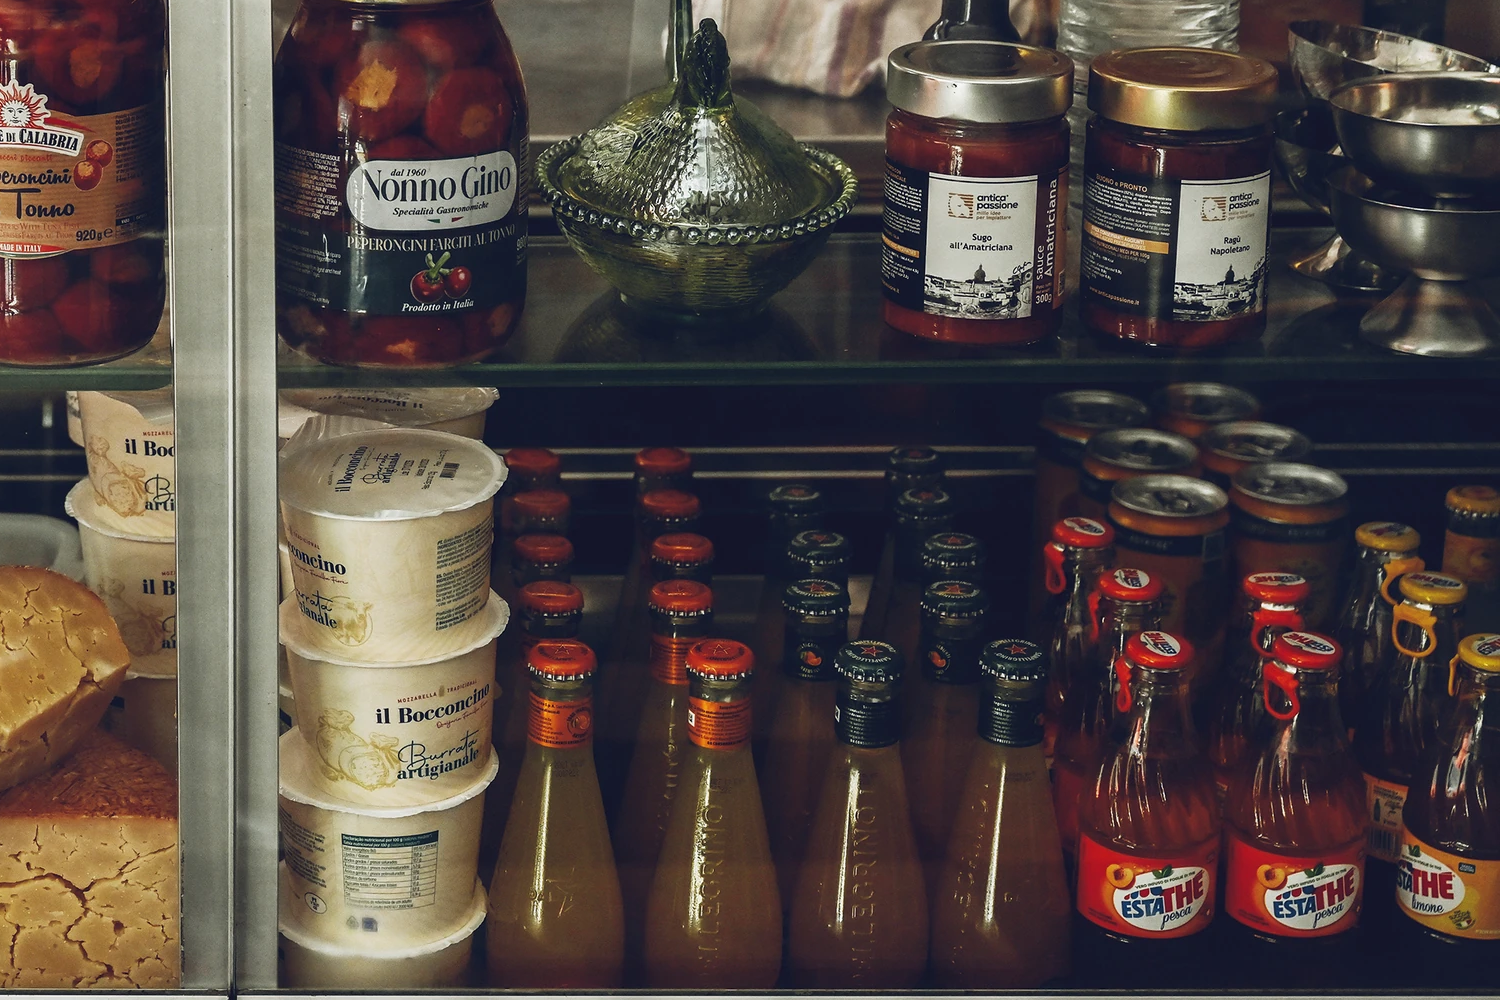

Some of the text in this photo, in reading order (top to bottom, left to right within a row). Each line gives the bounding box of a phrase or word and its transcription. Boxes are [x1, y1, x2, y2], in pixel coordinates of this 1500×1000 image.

[6, 132, 16, 143] DI
[19, 128, 79, 151] CALABRIA
[390, 168, 427, 178] dal 1960
[363, 168, 457, 202] Nonno
[460, 165, 511, 200] Gino
[1119, 181, 1148, 193] PRONTO
[0, 187, 75, 220] Tonno
[976, 194, 1006, 203] antica
[1228, 198, 1260, 212] passione
[1229, 192, 1253, 202] antica
[392, 200, 490, 218] Specialità Gastronomiche
[976, 200, 1018, 212] passione
[1044, 178, 1058, 278] Amatriciana
[347, 235, 427, 253] PEPERONCINI
[430, 233, 472, 251] FARCITI
[473, 232, 487, 247] AL
[488, 223, 516, 243] TONNO
[949, 241, 1013, 252] all'Amatriciana
[971, 233, 992, 244] Sugo
[1223, 235, 1241, 246] Ragù
[16, 243, 23, 252] IN
[24, 243, 42, 253] ITALY
[1210, 244, 1251, 256] Napoletano
[1036, 245, 1045, 281] sauce
[401, 298, 475, 313] Prodotto in Italia
[125, 438, 137, 455] il
[336, 445, 369, 486] Bocconcino
[143, 579, 155, 595] il
[376, 707, 391, 725] il
[398, 683, 490, 724] Bocconcino
[397, 691, 438, 704] MOZZARELLA
[397, 729, 480, 771] Burrata
[396, 747, 480, 781] artigianale
[1411, 893, 1444, 914] limone
[1161, 905, 1193, 931] pesca
[1313, 902, 1344, 929] pesca
